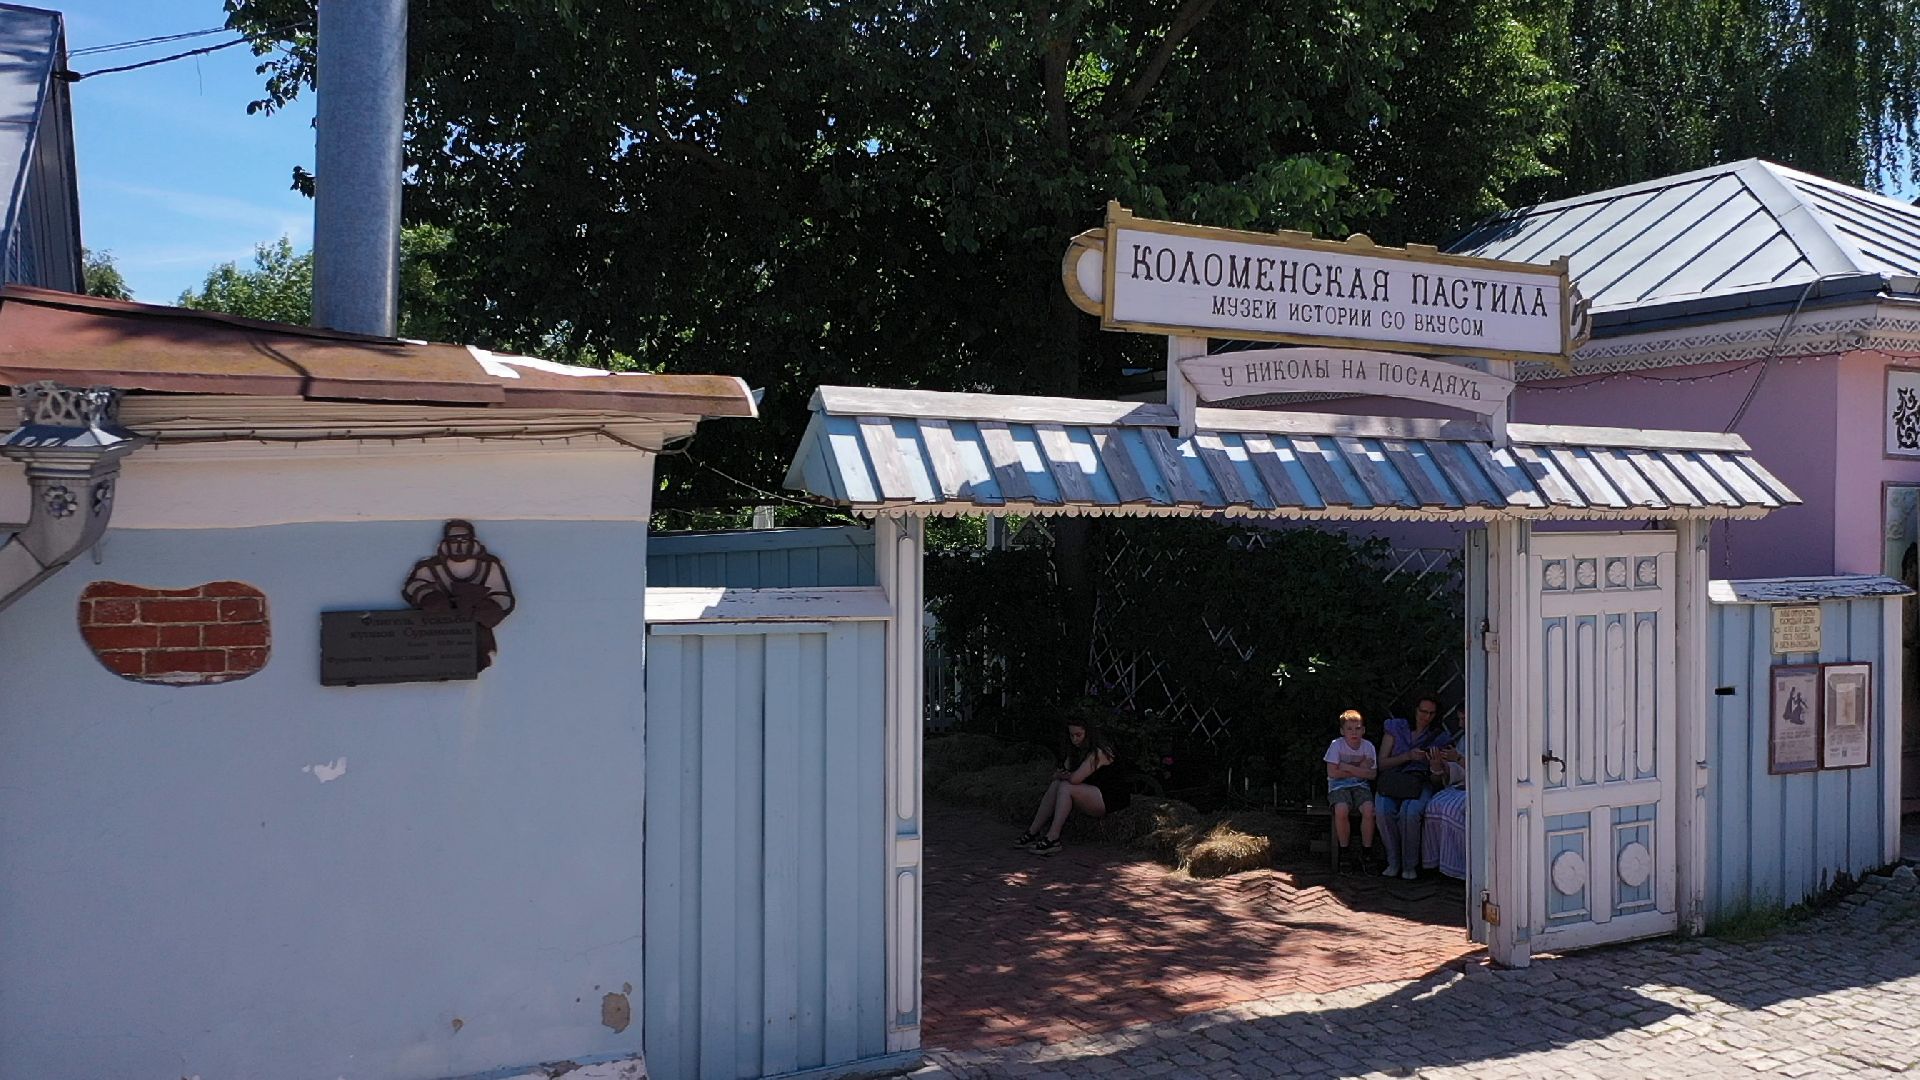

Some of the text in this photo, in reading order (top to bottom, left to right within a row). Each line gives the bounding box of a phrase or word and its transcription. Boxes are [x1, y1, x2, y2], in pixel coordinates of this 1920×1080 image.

[1131, 244, 1548, 317] КОЛОМЕНСКАЯ ПАСТИЛА
[1212, 296, 1484, 337] МУЗЕЙ ИСТОРИИ СО ВКУСОМ
[1221, 359, 1481, 401] У НИКОЛЫ НА ПОСАДЯХЪ
